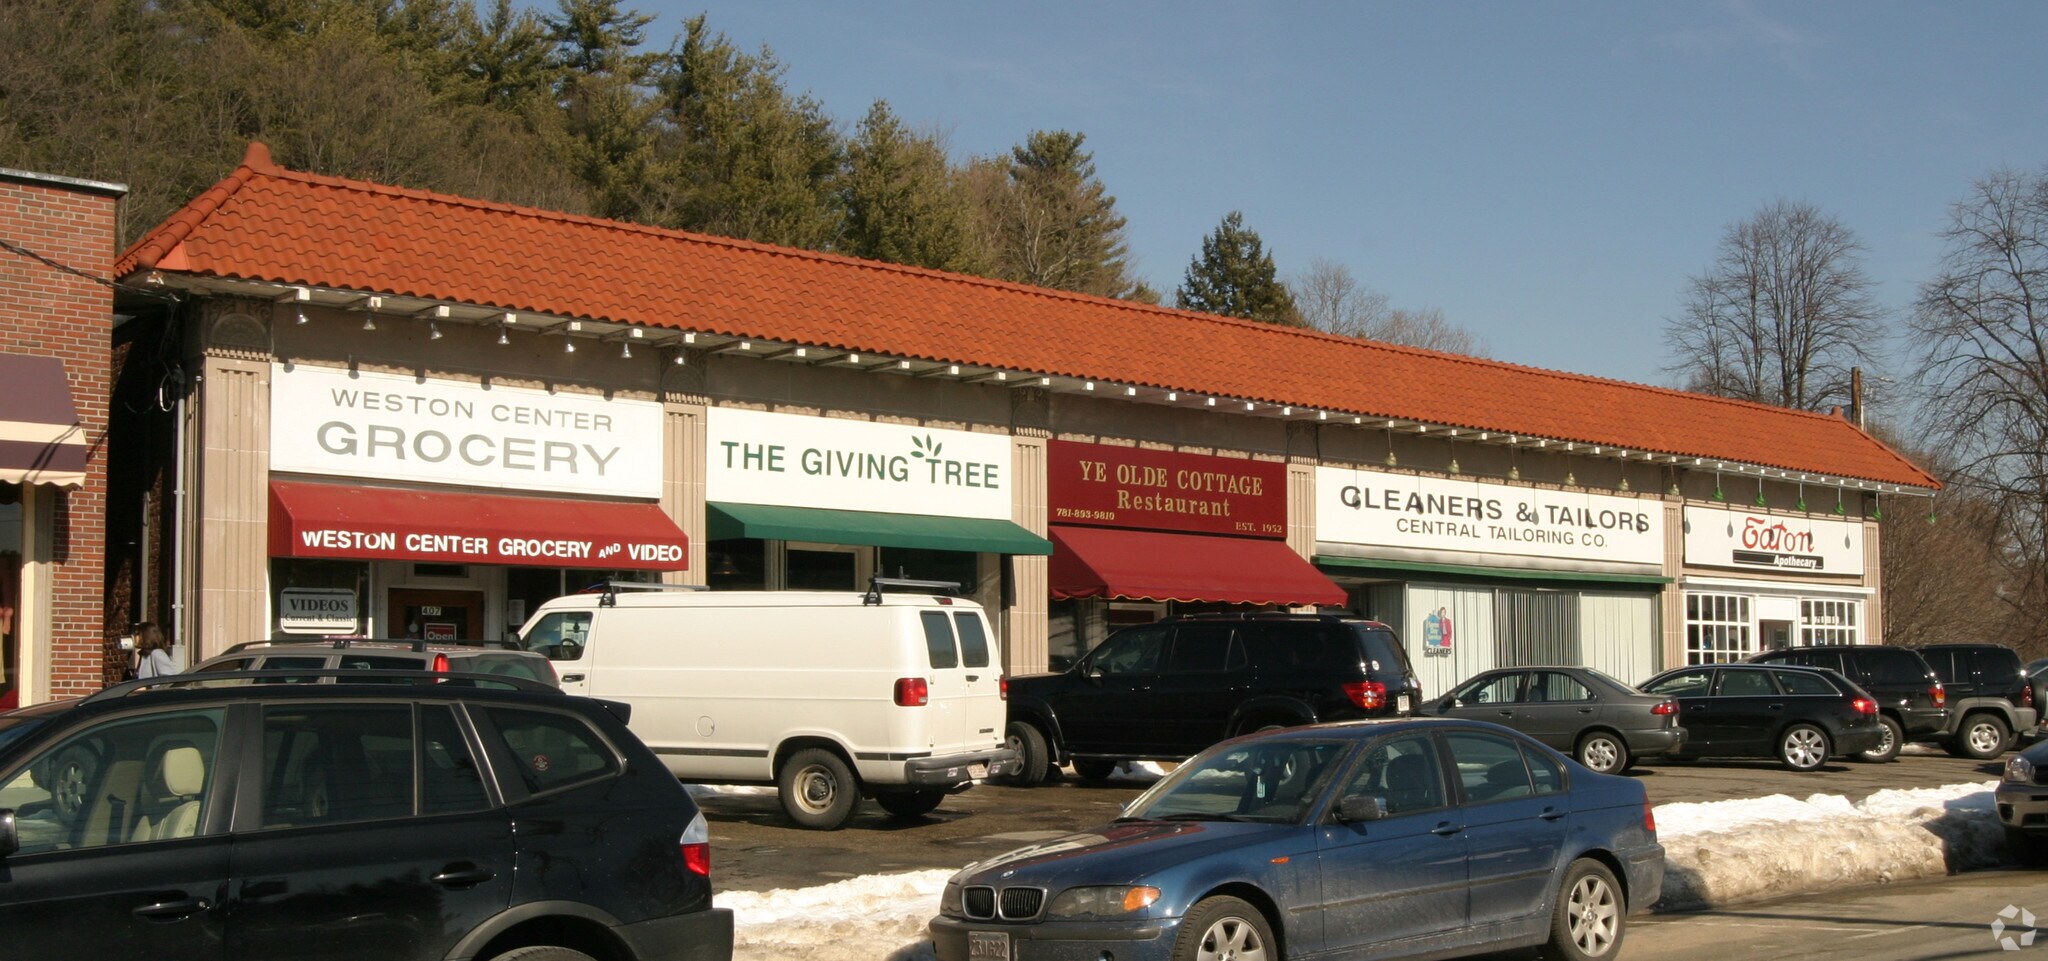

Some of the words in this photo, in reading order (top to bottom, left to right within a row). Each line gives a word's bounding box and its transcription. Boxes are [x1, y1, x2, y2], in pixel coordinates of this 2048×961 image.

[331, 388, 474, 419] WESTON
[491, 404, 612, 433] CENTER
[316, 420, 621, 476] GROCERY
[720, 441, 785, 472] THE
[801, 448, 908, 482] GIVING
[926, 458, 999, 489] TREE
[1079, 460, 1107, 482] YE
[1116, 464, 1168, 488] OLDE
[1177, 470, 1263, 496] COTTAGE
[1056, 508, 1115, 521] 781-893-9810
[1117, 490, 1230, 517] Restaurant
[1340, 485, 1503, 520] CLEANERS
[1516, 502, 1533, 522] &
[1545, 504, 1650, 532] TAILORS
[1235, 522, 1256, 532] EST.
[1262, 524, 1282, 533] 1952
[1396, 518, 1481, 539] CENTRAL
[1488, 526, 1574, 546] TAILORING
[1581, 533, 1608, 548] CO.
[1742, 517, 1814, 553] Eaton
[302, 530, 395, 550] WESTON
[405, 534, 488, 555] CENTER
[498, 538, 592, 559] GROCERY
[598, 543, 621, 559] AND
[628, 544, 682, 562] VIDEO
[1774, 555, 1817, 568] Apothecary
[285, 613, 315, 621] Current
[290, 599, 348, 612] VIDEOS
[422, 607, 441, 615] 407
